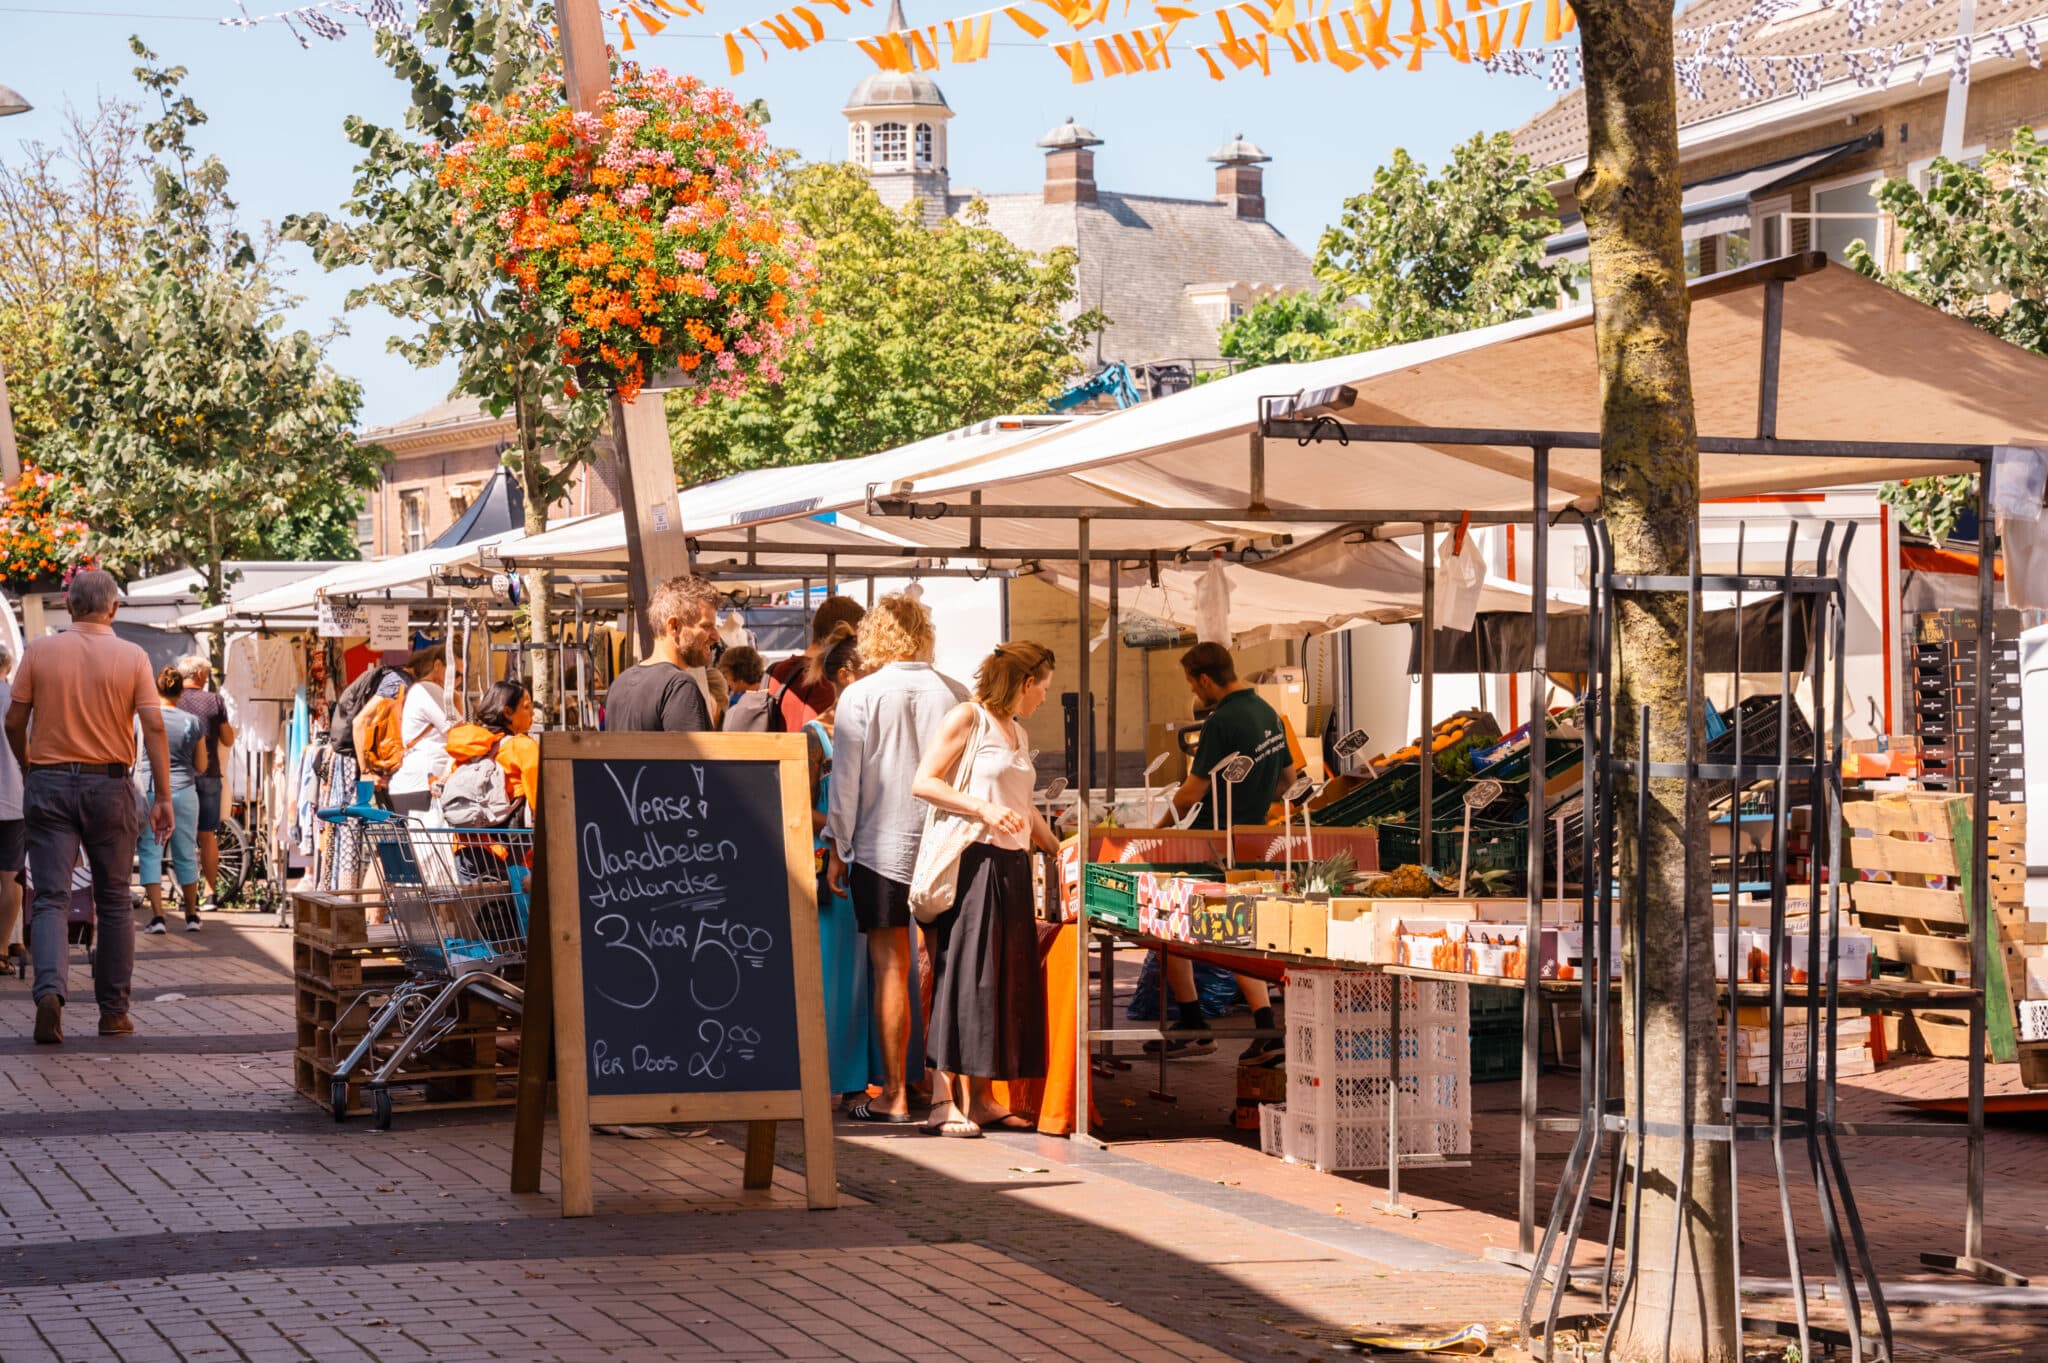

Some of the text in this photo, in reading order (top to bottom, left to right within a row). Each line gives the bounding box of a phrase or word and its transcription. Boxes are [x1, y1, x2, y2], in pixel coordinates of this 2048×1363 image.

[603, 762, 708, 826] Verse!
[583, 822, 738, 879] Aardbeien
[589, 867, 726, 908] Hollandse
[594, 914, 659, 1009] 3
[632, 1044, 679, 1072] Doos
